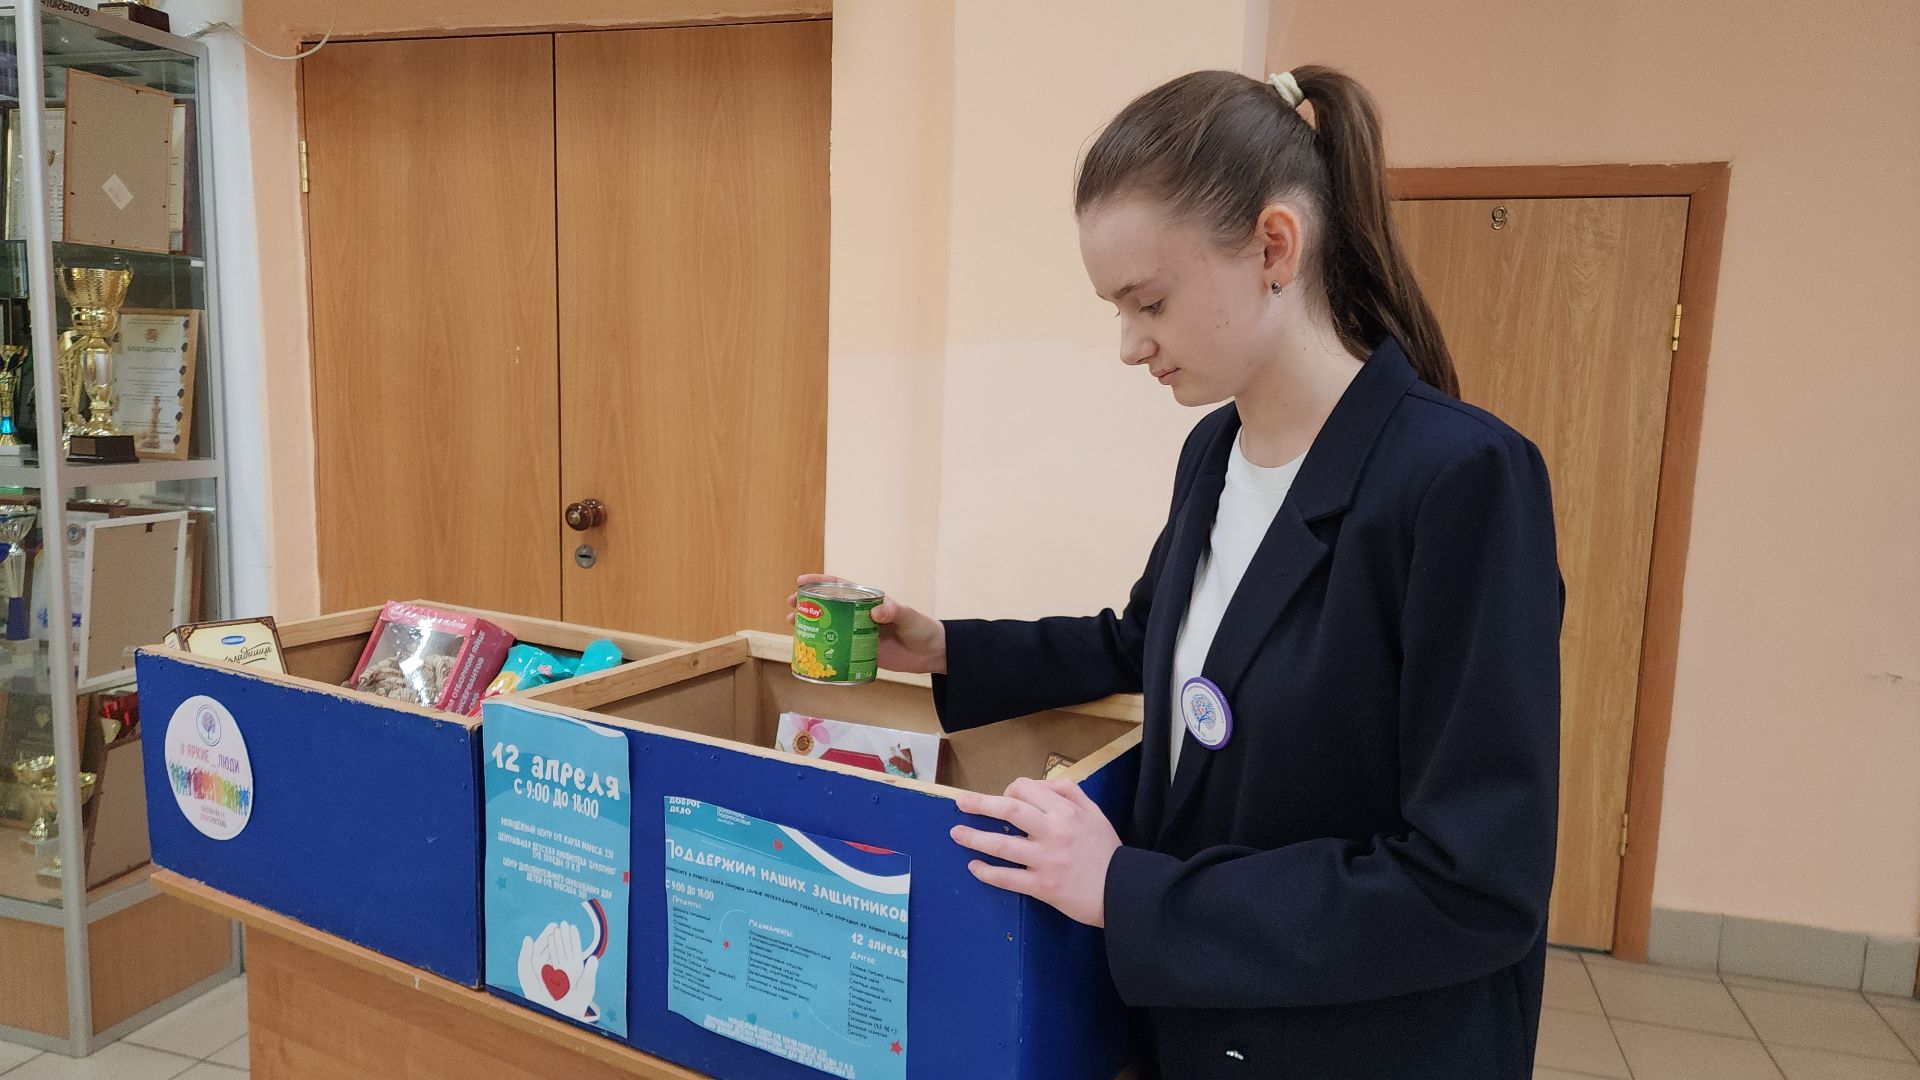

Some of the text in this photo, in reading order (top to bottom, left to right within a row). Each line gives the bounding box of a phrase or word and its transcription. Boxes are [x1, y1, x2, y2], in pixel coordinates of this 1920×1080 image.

[1491, 206, 1508, 230] 9
[452, 653, 475, 699] ОТБОРНОМ
[472, 630, 486, 654] ЯЙЦЕ
[456, 656, 484, 714] ОНСЕРВАНТОВ
[491, 742, 620, 800] 12 апреля
[526, 780, 550, 803] 9:00
[572, 793, 599, 819] 18:00
[669, 796, 701, 808] ДОБРОЕ
[669, 805, 692, 816] ДЕЛО
[761, 869, 806, 893] НАШИХ
[812, 884, 908, 923] ЗАЩИТНИКОВ
[851, 932, 864, 946] 12
